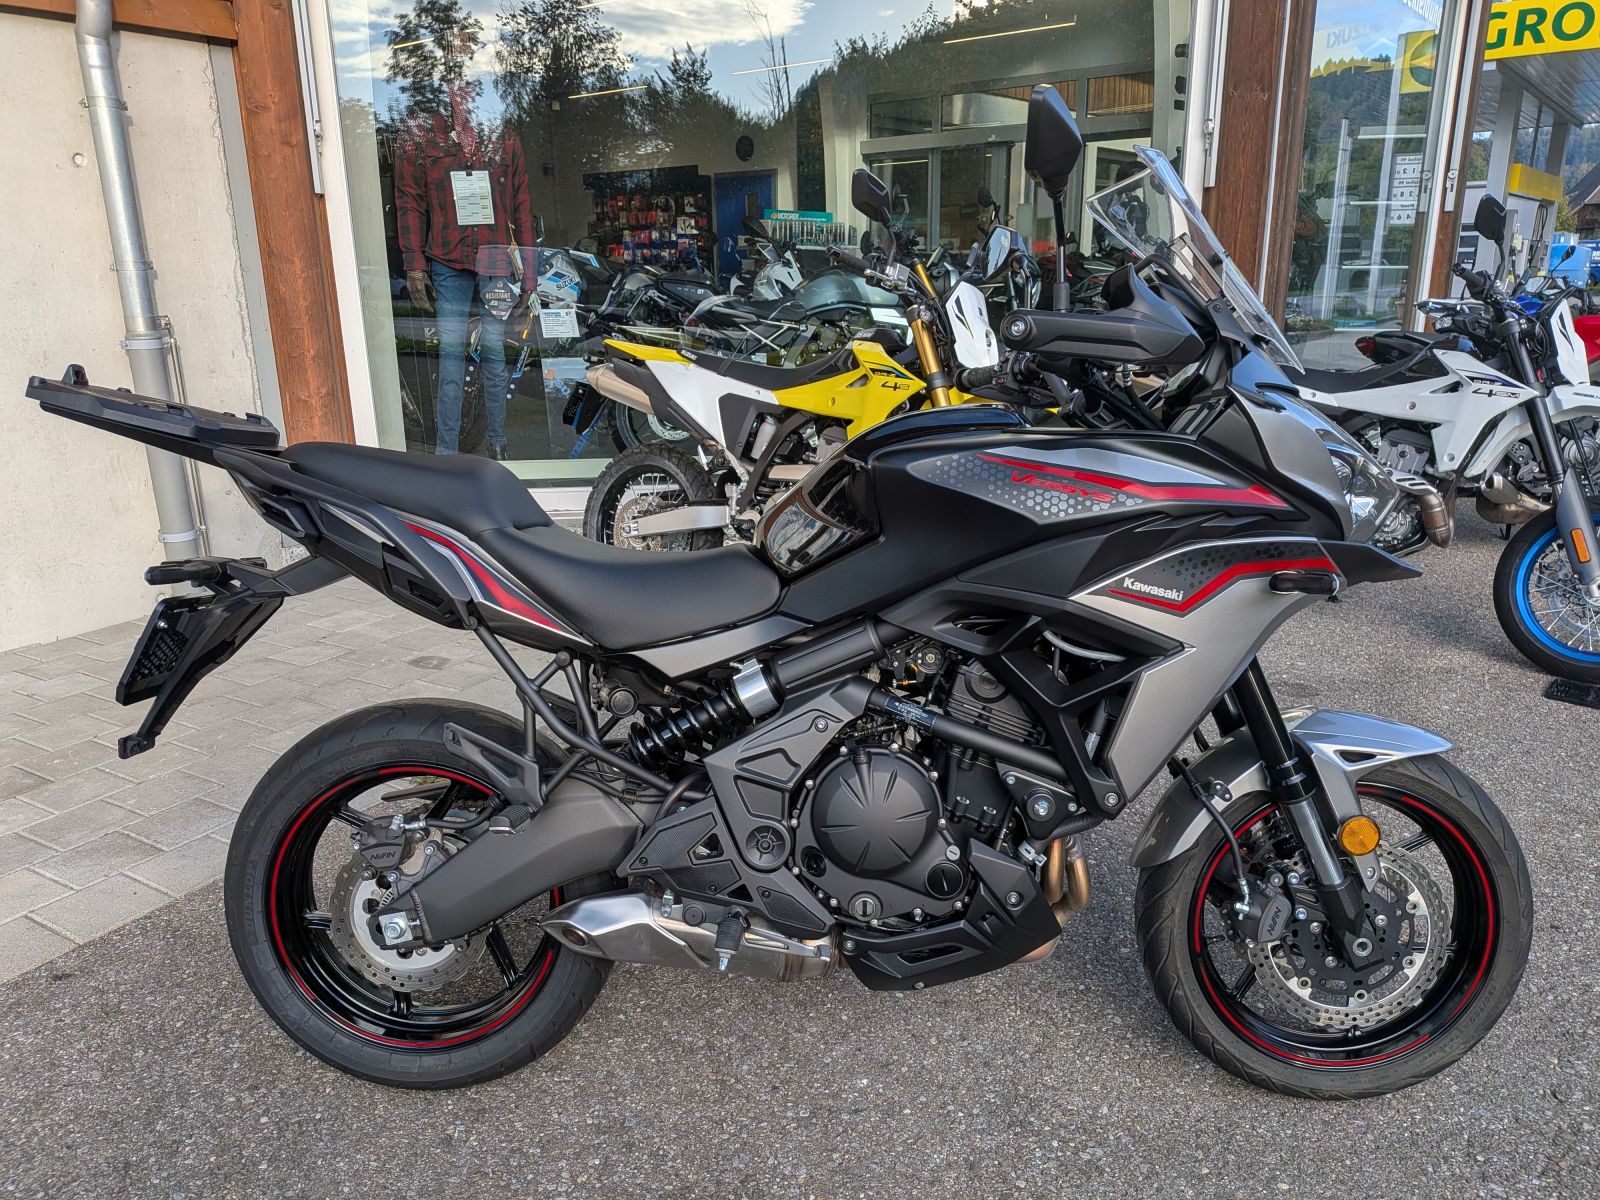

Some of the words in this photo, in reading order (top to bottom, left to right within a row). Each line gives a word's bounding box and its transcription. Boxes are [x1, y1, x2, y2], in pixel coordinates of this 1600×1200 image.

[777, 212, 800, 220] MOTOREX
[555, 275, 577, 291] SUZUKI
[680, 349, 698, 361] SUZUKI
[1011, 470, 1116, 503] VERSYS
[1123, 576, 1184, 601] Kawasaki
[370, 851, 397, 861] NISSIN
[1267, 905, 1282, 937] NISSIN
